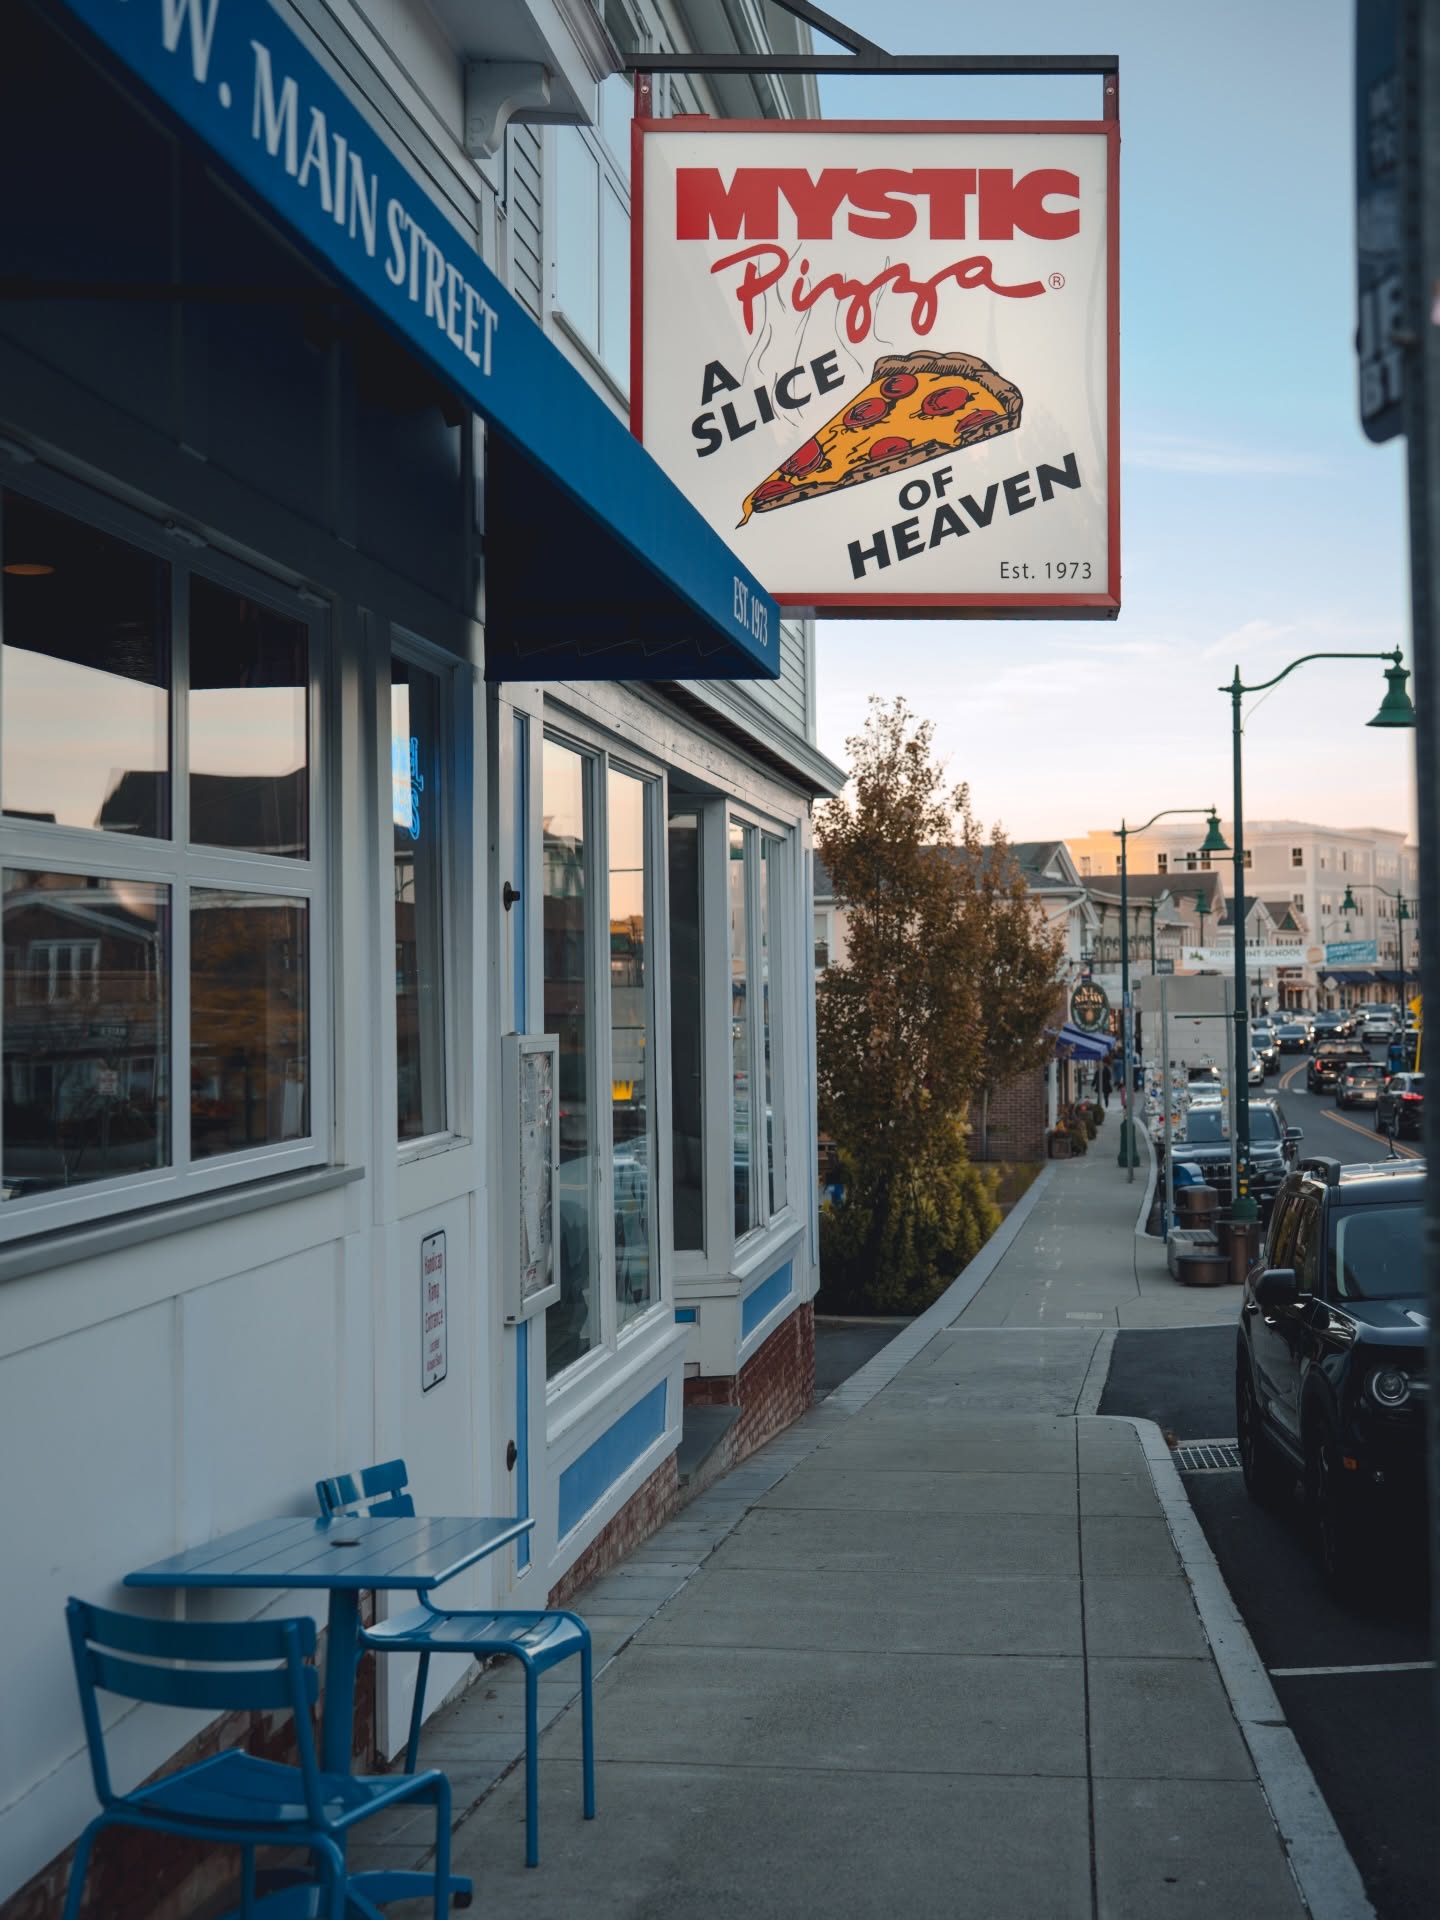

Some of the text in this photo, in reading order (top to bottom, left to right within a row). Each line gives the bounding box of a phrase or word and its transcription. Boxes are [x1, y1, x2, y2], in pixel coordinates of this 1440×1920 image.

[250, 39, 378, 257] MAIN
[384, 198, 498, 377] STREET
[676, 168, 1080, 240] MYSTIC
[710, 243, 1046, 344] Pizza
[691, 349, 846, 458] SLICE
[700, 359, 742, 406] A
[847, 452, 1082, 580] HEAVEN
[898, 466, 954, 511] OF
[1000, 561, 1092, 579] Est. 1973
[733, 575, 768, 647] EST. 1973
[1209, 950, 1231, 958] PINE
[1264, 948, 1303, 958] SCHOOL
